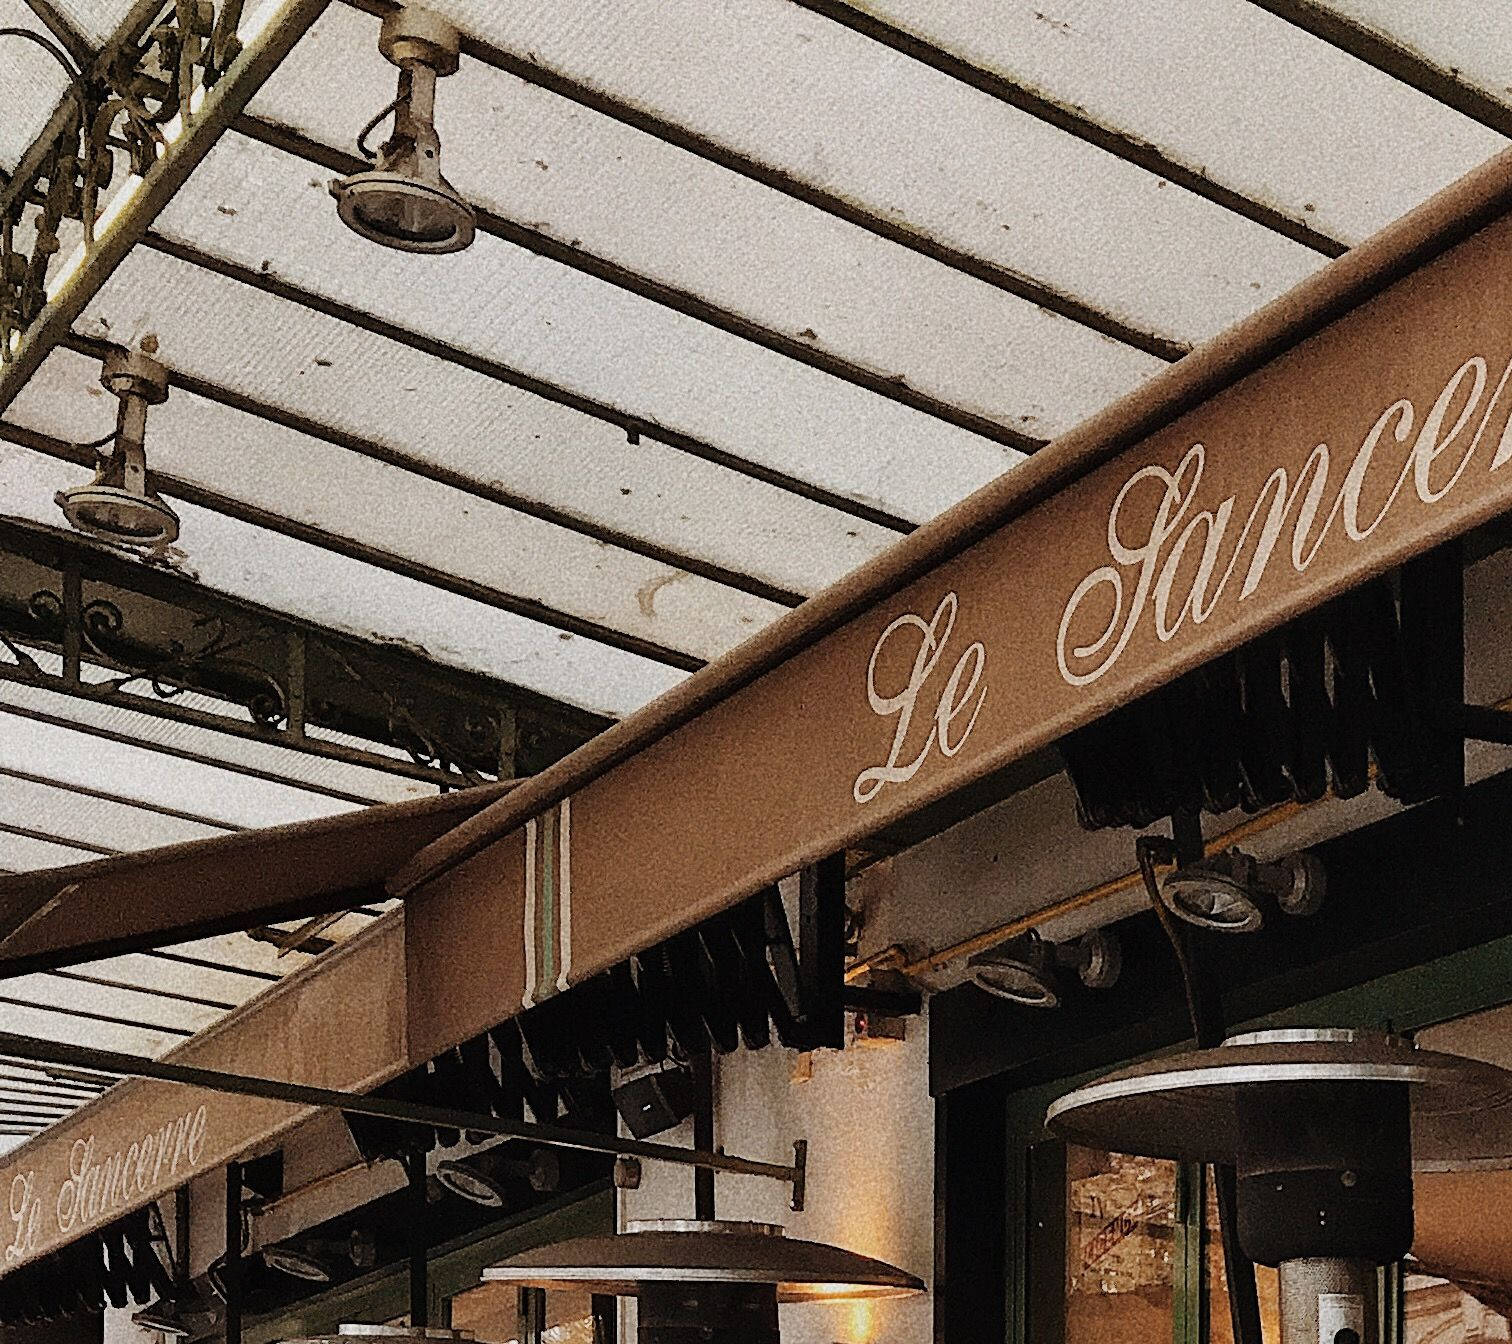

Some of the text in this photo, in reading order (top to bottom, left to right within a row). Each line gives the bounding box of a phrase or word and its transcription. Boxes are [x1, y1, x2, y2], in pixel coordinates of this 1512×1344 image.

[853, 590, 989, 804] Le
[4, 1104, 207, 1262] Le Sancerre
